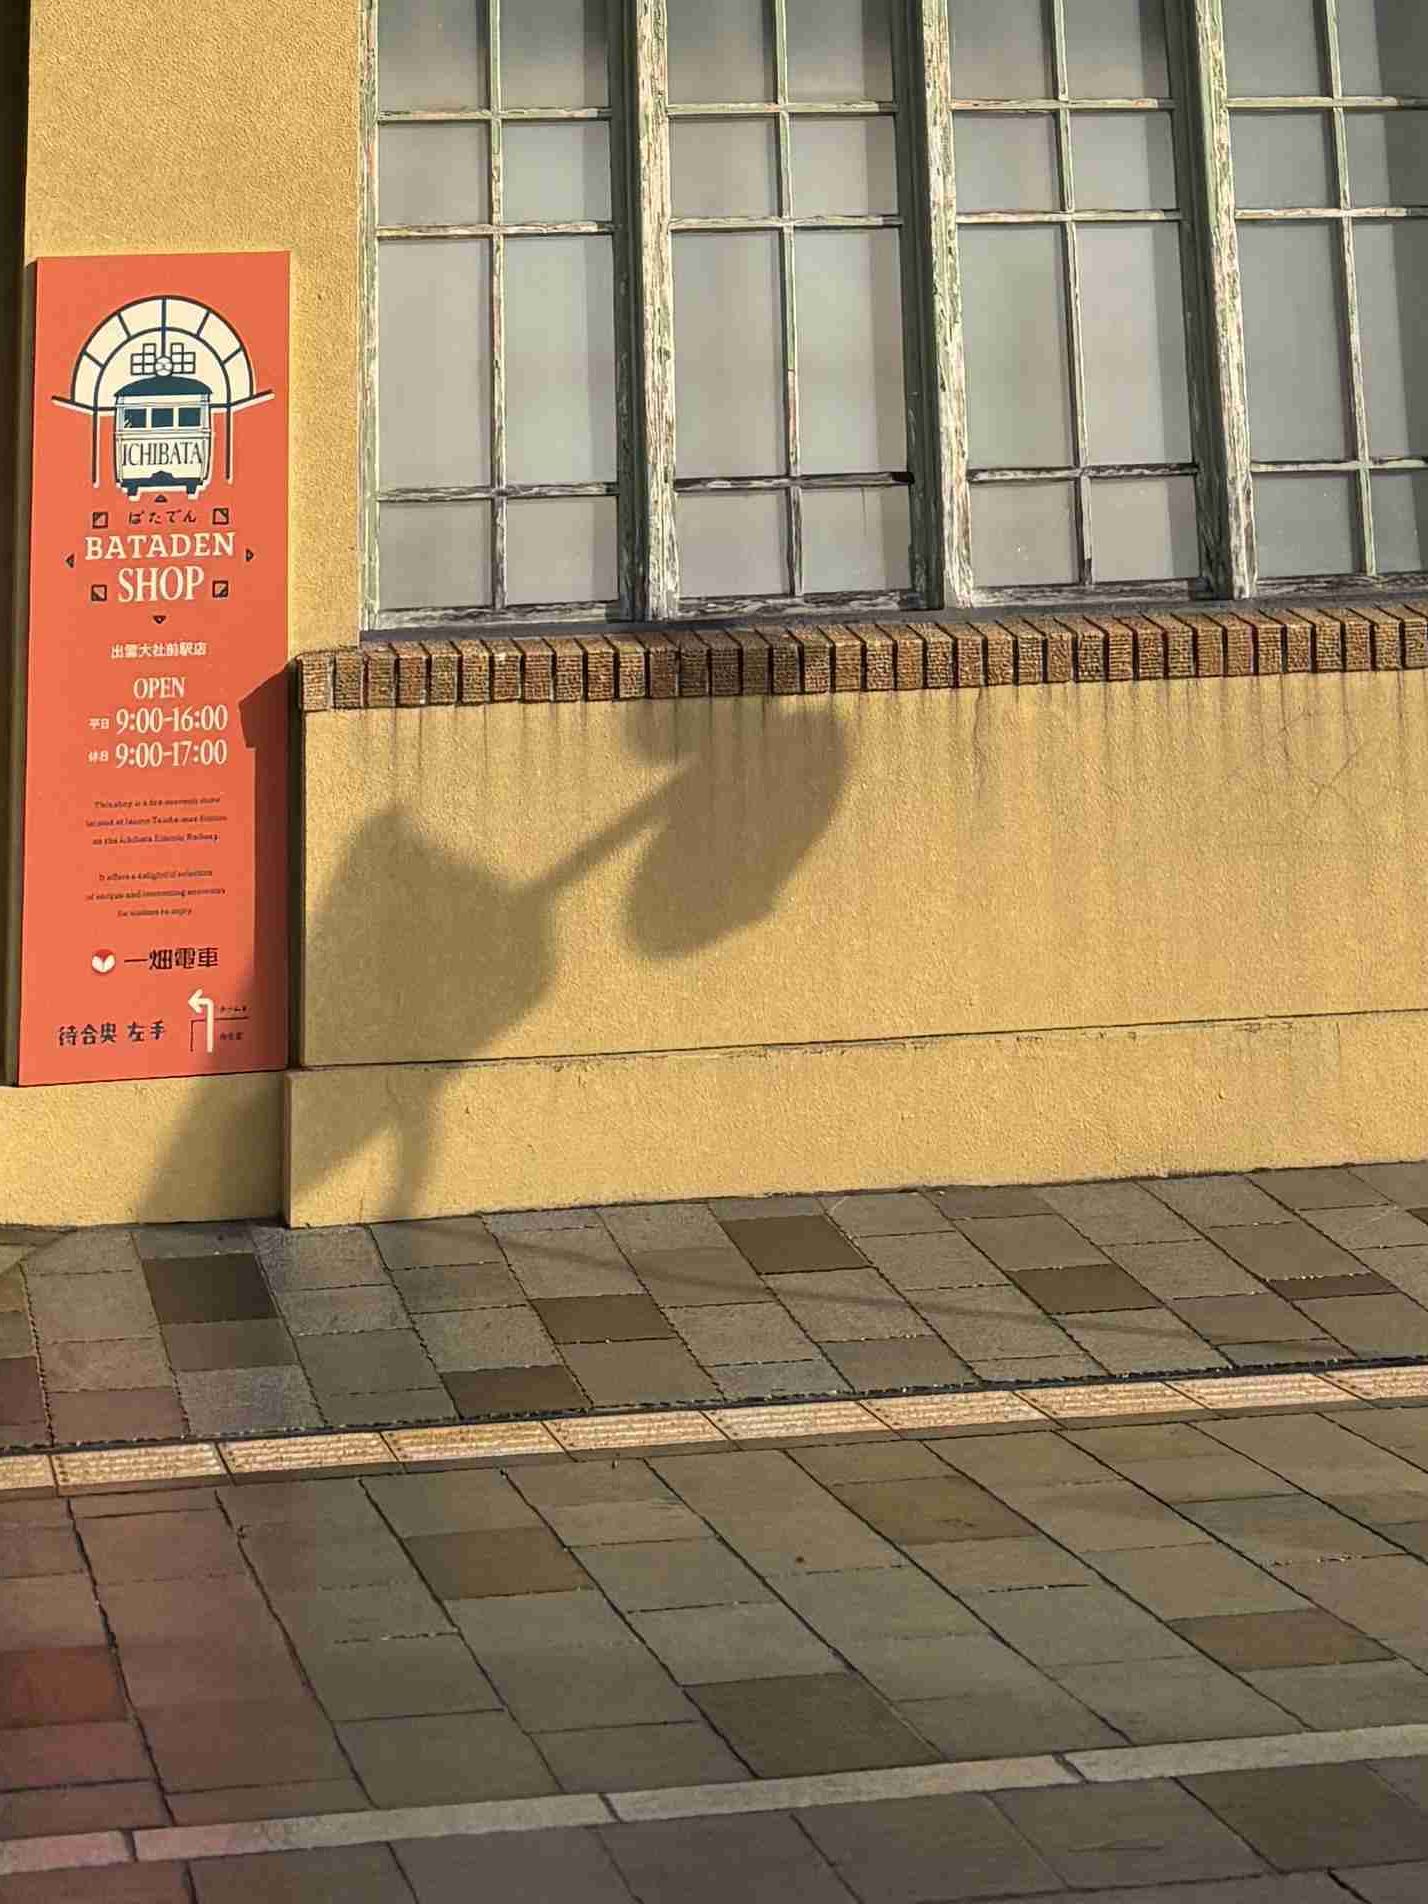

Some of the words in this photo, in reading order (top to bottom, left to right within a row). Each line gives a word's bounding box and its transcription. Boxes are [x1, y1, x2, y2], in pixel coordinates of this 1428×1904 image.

[122, 440, 204, 467] ICHIBATA
[128, 510, 197, 525] ばたでん
[85, 532, 234, 560] BATADEN
[118, 566, 205, 603] SHOP
[111, 642, 207, 659] 出雲大社前駅店
[133, 676, 186, 699] OPEN
[116, 704, 228, 735] 9:00-16:00
[115, 739, 227, 768] 9:00-17:00
[123, 947, 219, 970] 一畑電車
[127, 1020, 166, 1042] 左手
